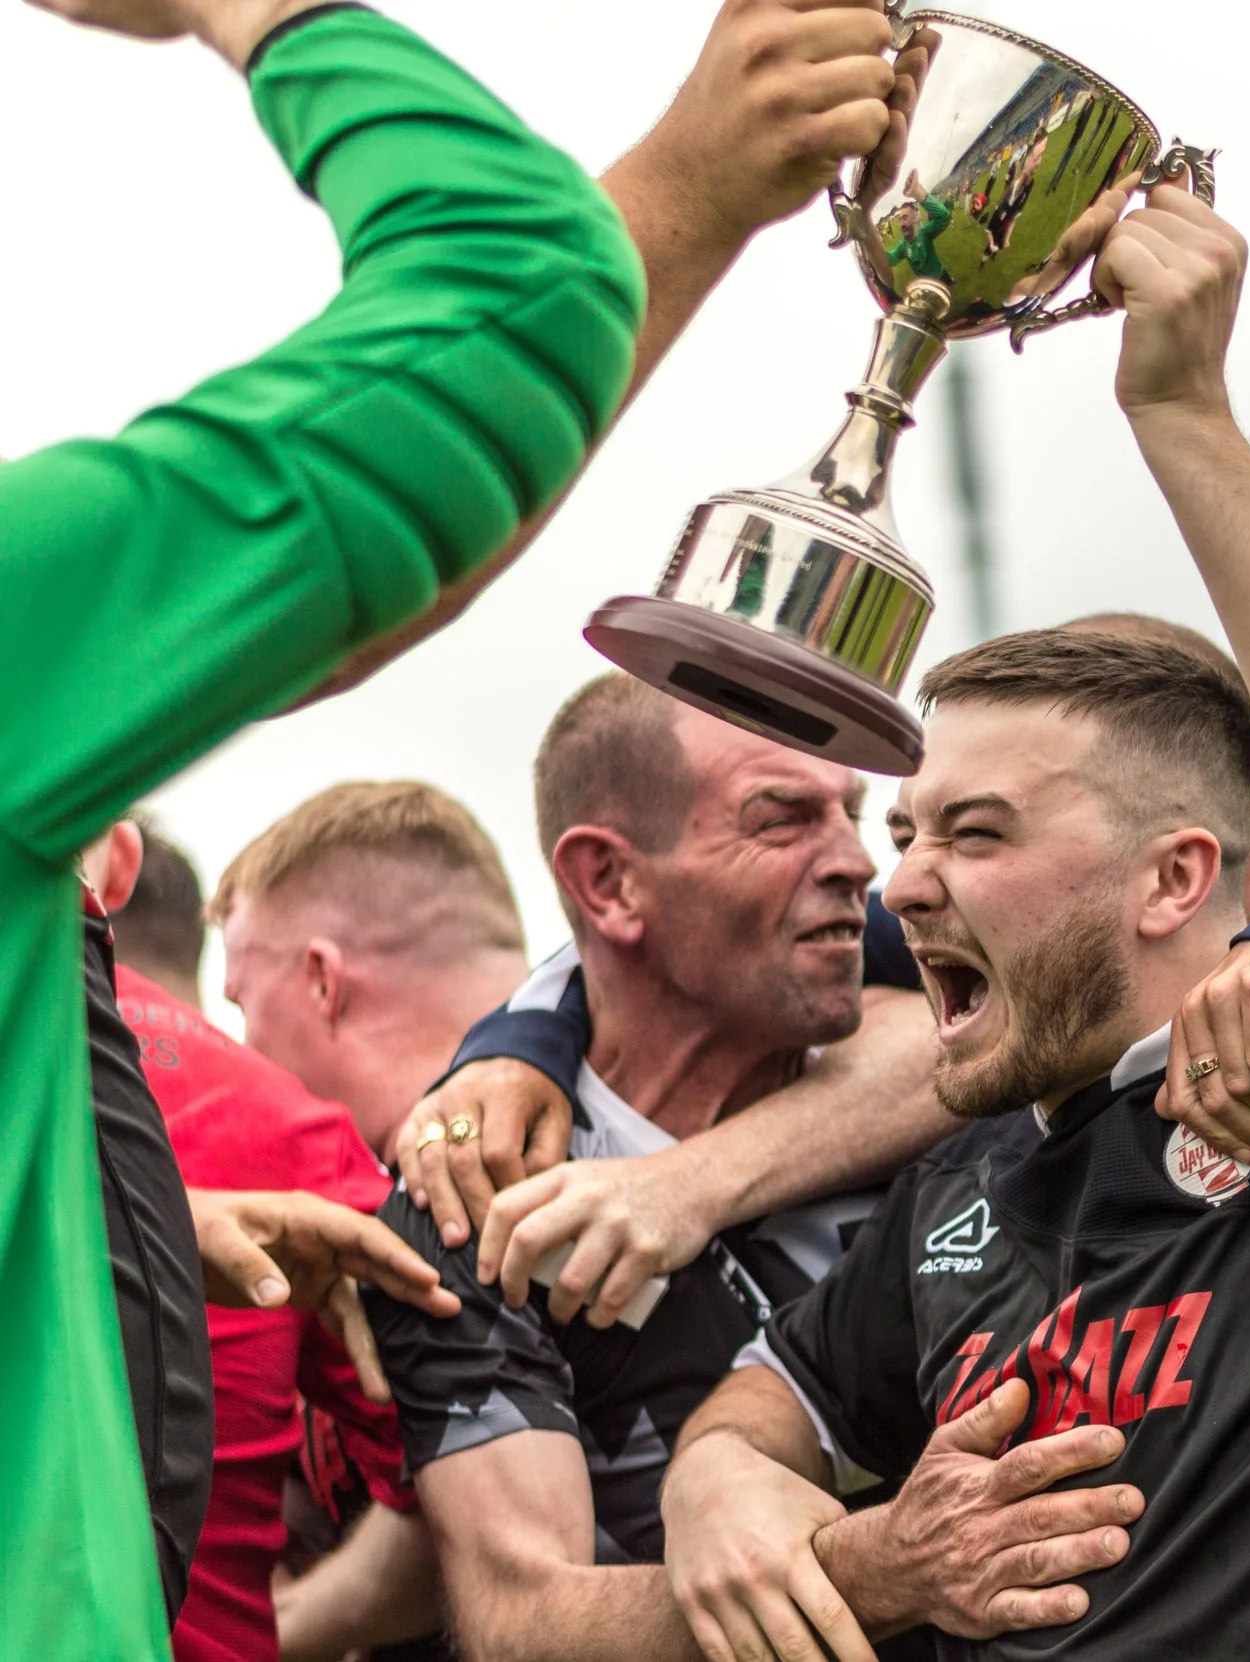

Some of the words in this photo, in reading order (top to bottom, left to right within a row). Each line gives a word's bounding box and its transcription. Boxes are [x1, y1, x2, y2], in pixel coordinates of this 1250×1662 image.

[1179, 1145, 1205, 1175] JAY
[917, 1257, 983, 1274] ACERBIS
[1027, 1285, 1213, 1441] BAZZ
